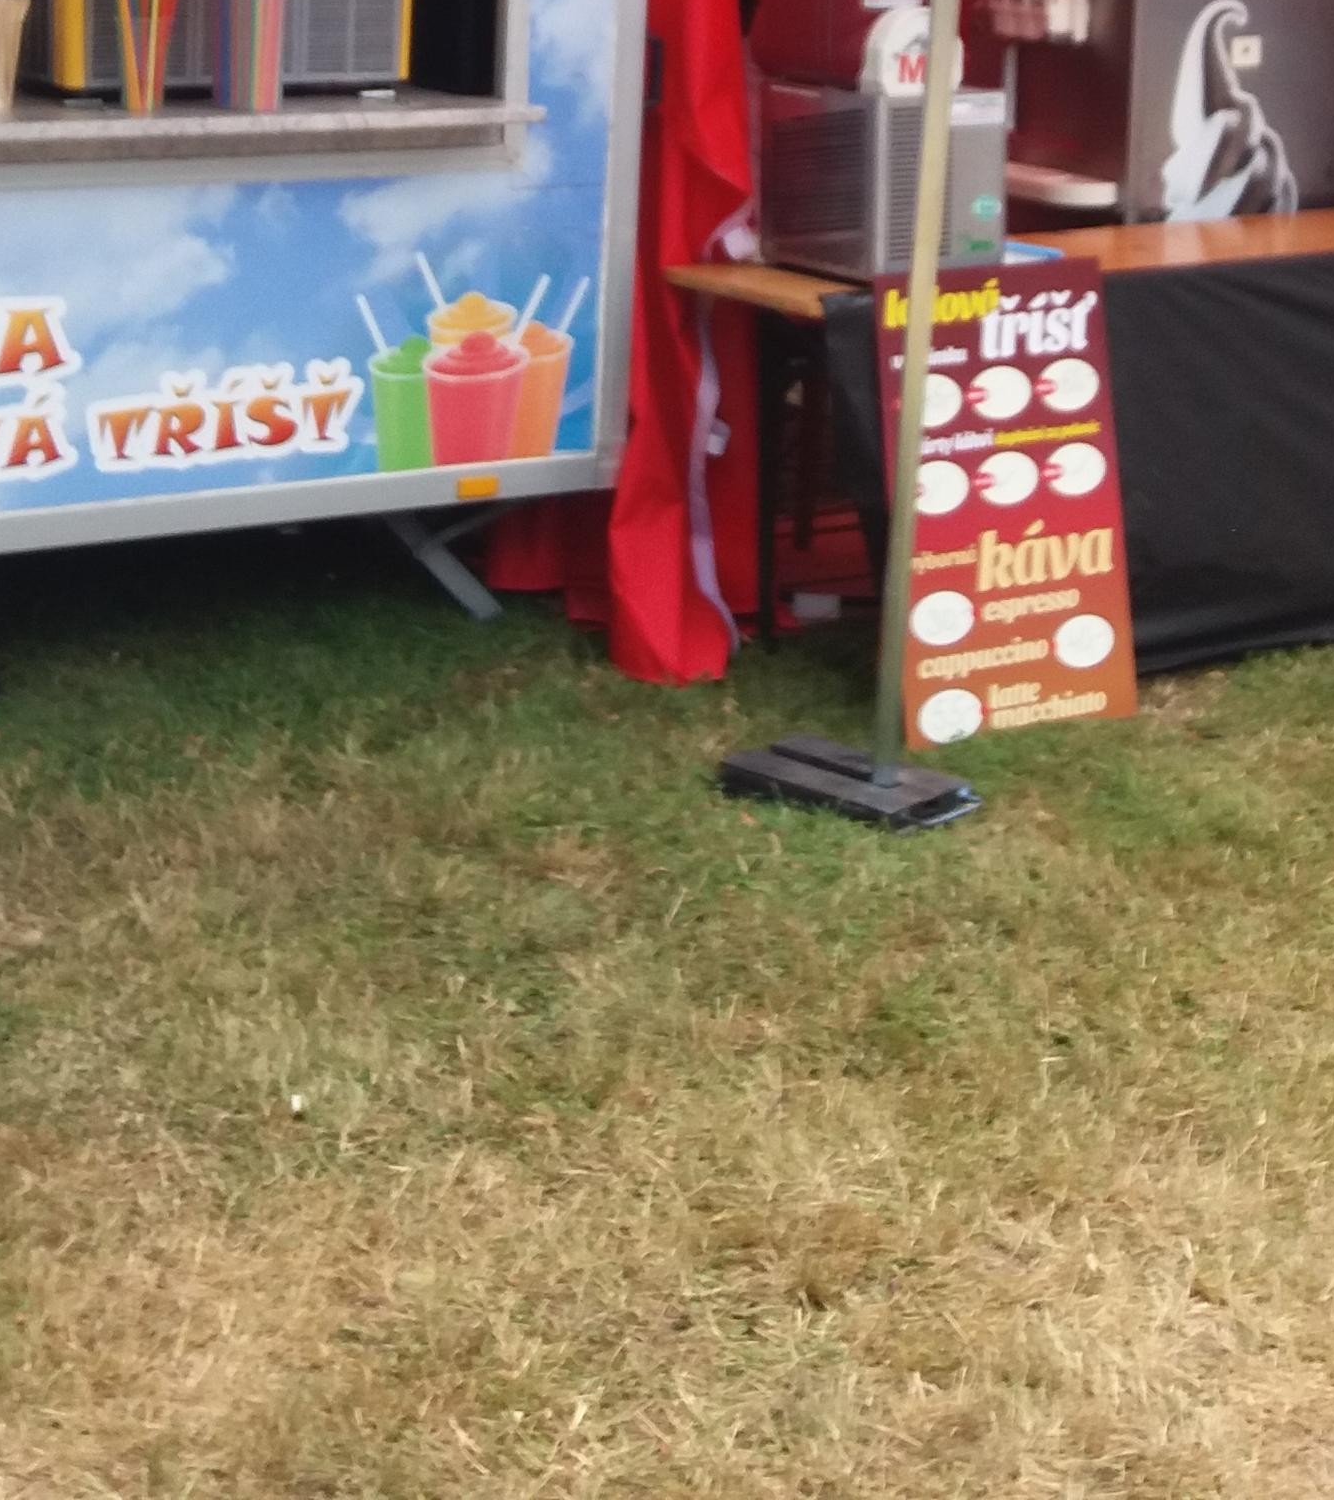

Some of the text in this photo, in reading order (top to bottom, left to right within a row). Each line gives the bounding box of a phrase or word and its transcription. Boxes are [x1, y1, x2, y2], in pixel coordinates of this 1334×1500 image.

[98, 371, 352, 462] TŘÍŠŤ
[977, 519, 1115, 592] káva
[982, 589, 1080, 623] espresso
[917, 637, 1049, 680] cappuccino
[989, 691, 1107, 730] macchiato
